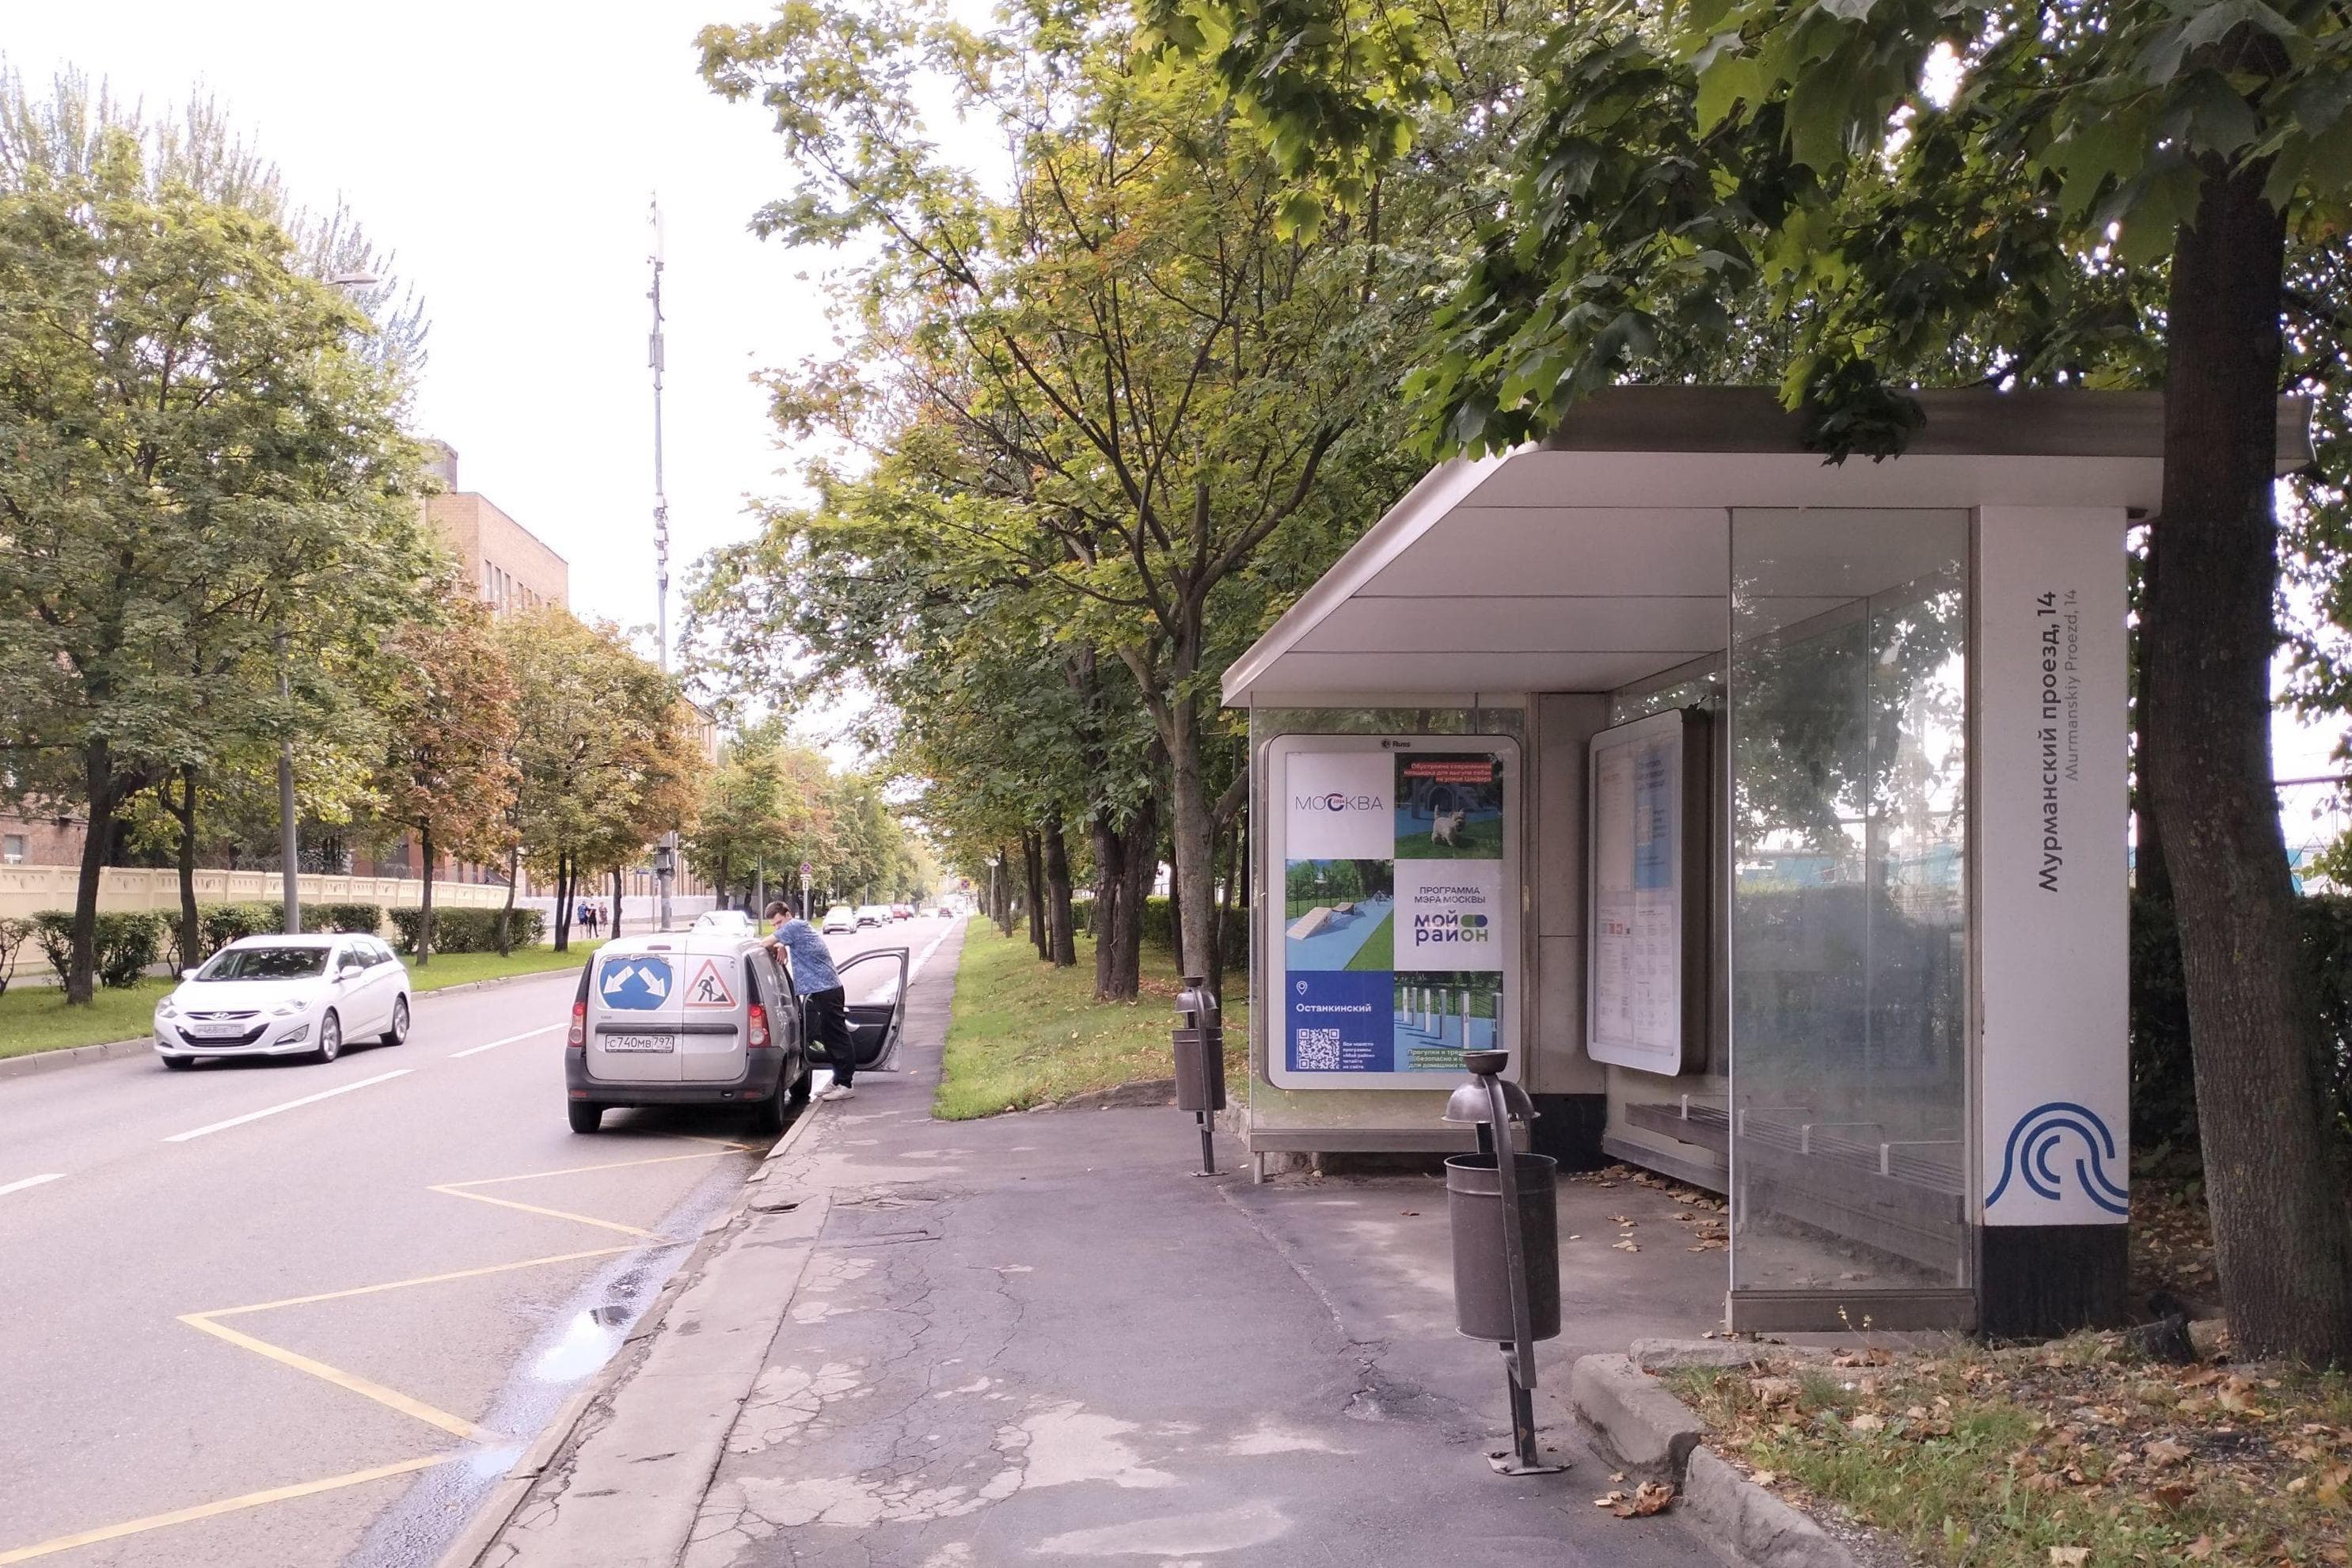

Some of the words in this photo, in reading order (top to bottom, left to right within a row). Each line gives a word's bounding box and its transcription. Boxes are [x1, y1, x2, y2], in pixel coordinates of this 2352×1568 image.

[2037, 591, 2057, 617] 14
[2064, 589, 2077, 606] 14
[2063, 610, 2080, 670] Proezd,
[2042, 624, 2061, 719] проезд,
[2064, 676, 2081, 781] Murmanskiy
[1295, 793, 1384, 811] МОСКВА
[2037, 730, 2062, 893] Мурманский
[1414, 909, 1458, 928] мой
[1296, 1003, 1372, 1012] Останкинский
[653, 1037, 671, 1046] 797
